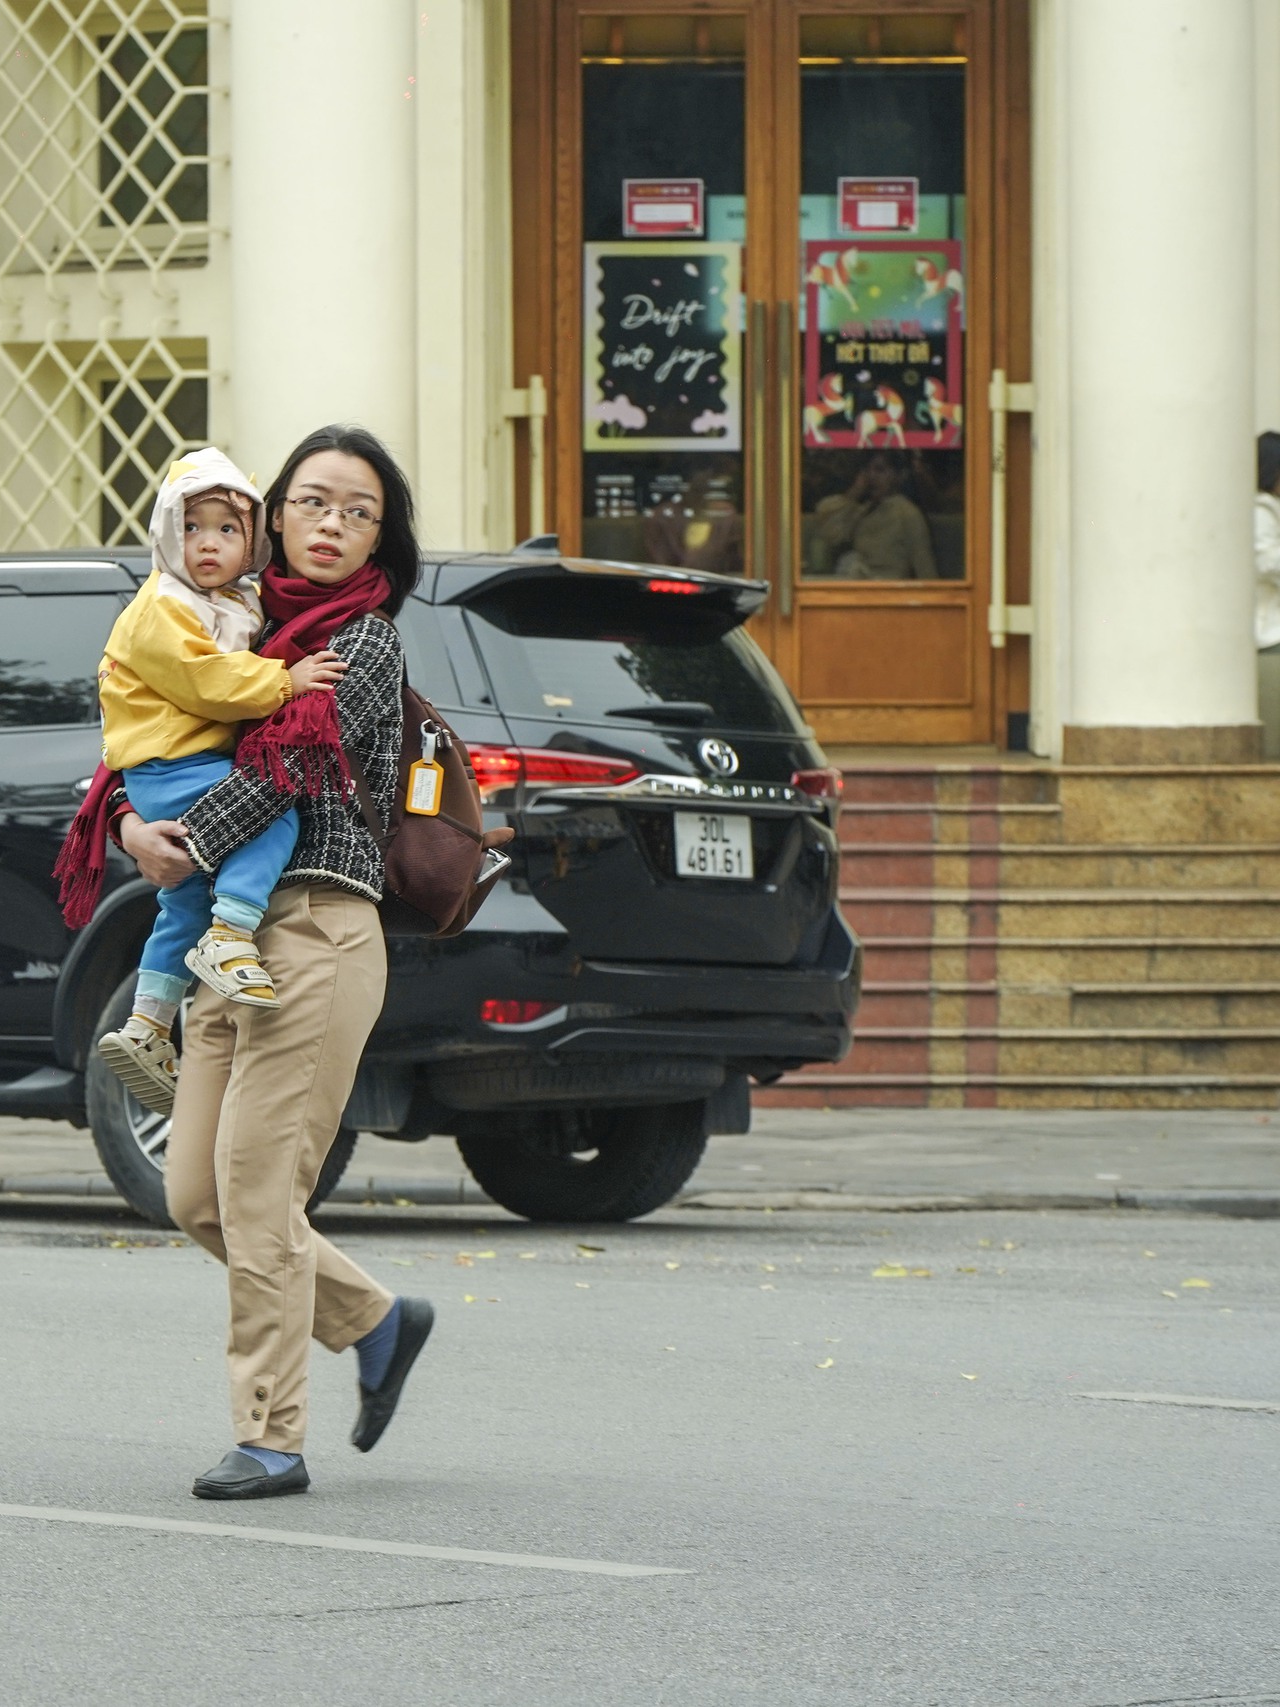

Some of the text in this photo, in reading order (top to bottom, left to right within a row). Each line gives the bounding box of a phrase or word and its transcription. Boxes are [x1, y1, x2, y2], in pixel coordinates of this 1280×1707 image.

[620, 294, 706, 338] Drift
[612, 344, 718, 383] into joy
[698, 817, 731, 843] 30L
